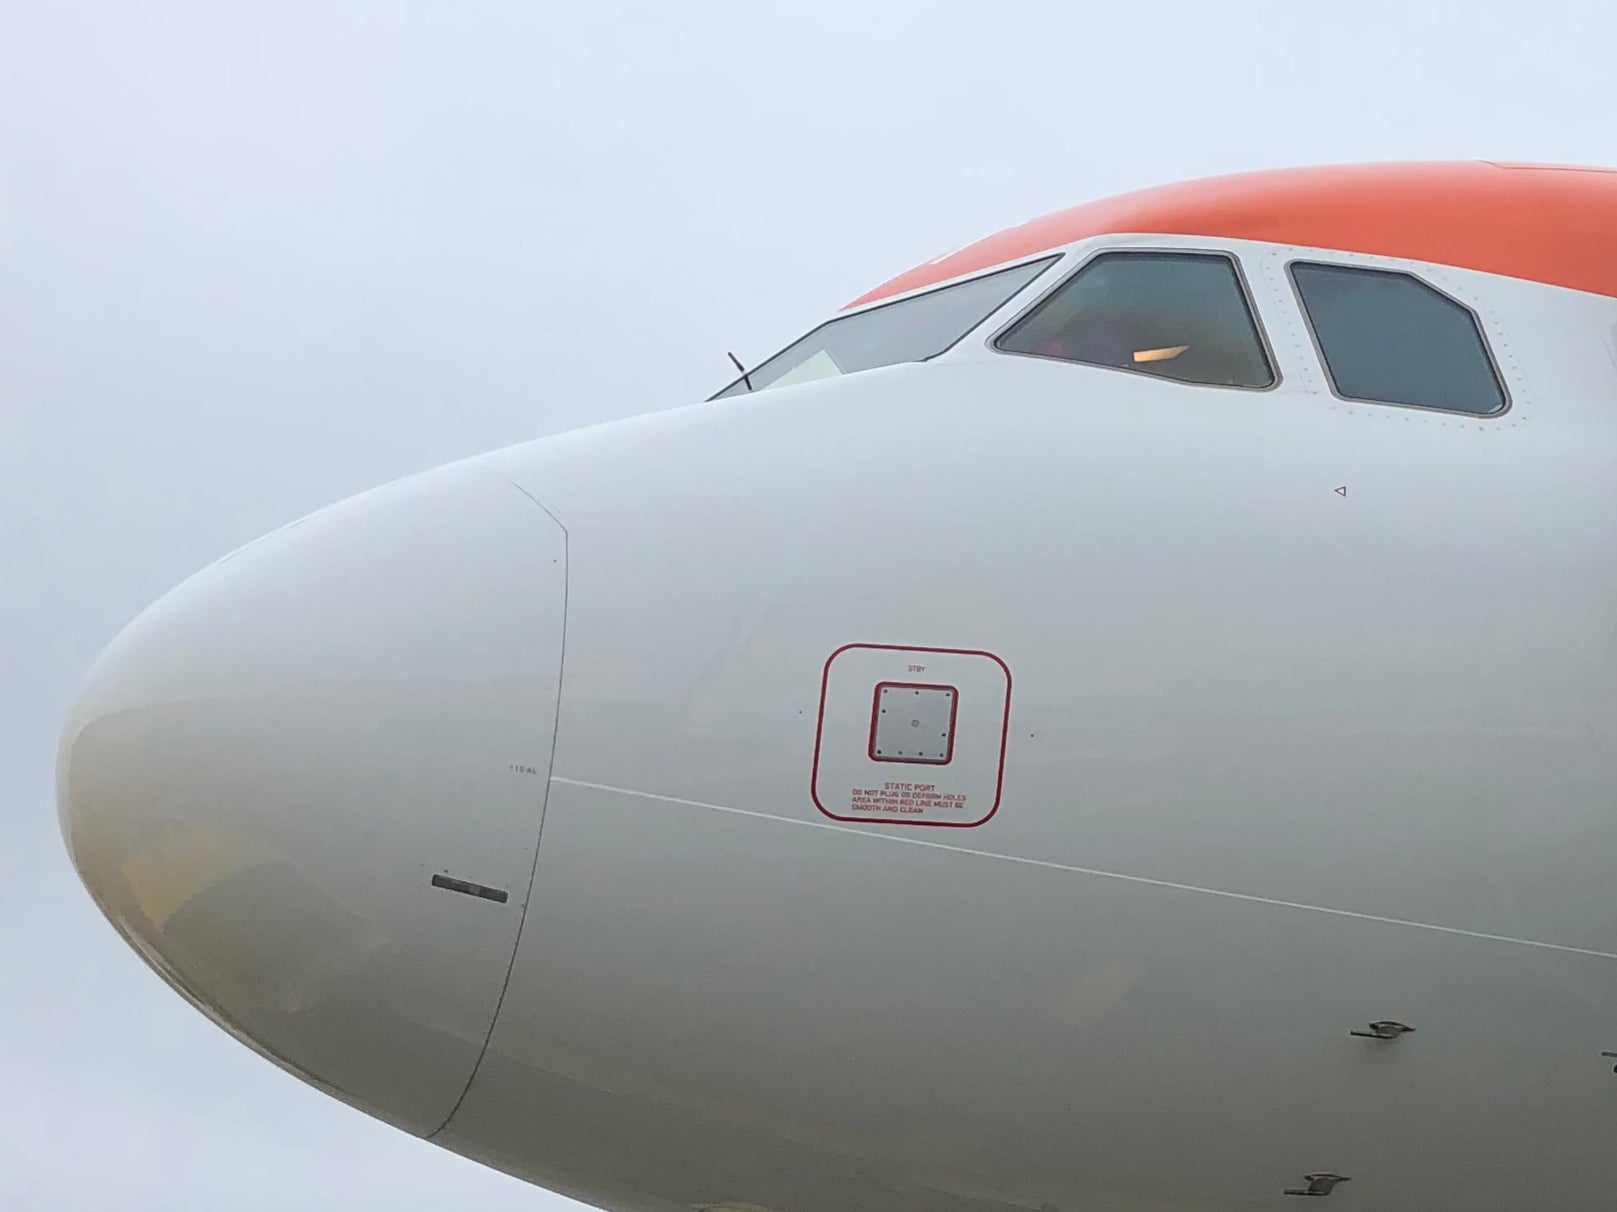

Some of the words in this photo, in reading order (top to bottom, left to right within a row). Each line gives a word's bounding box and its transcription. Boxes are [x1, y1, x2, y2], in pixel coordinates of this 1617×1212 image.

[907, 665, 926, 673] STBY
[884, 782, 912, 791] STATIC
[914, 783, 935, 792] PORT
[880, 790, 899, 798] PLUG
